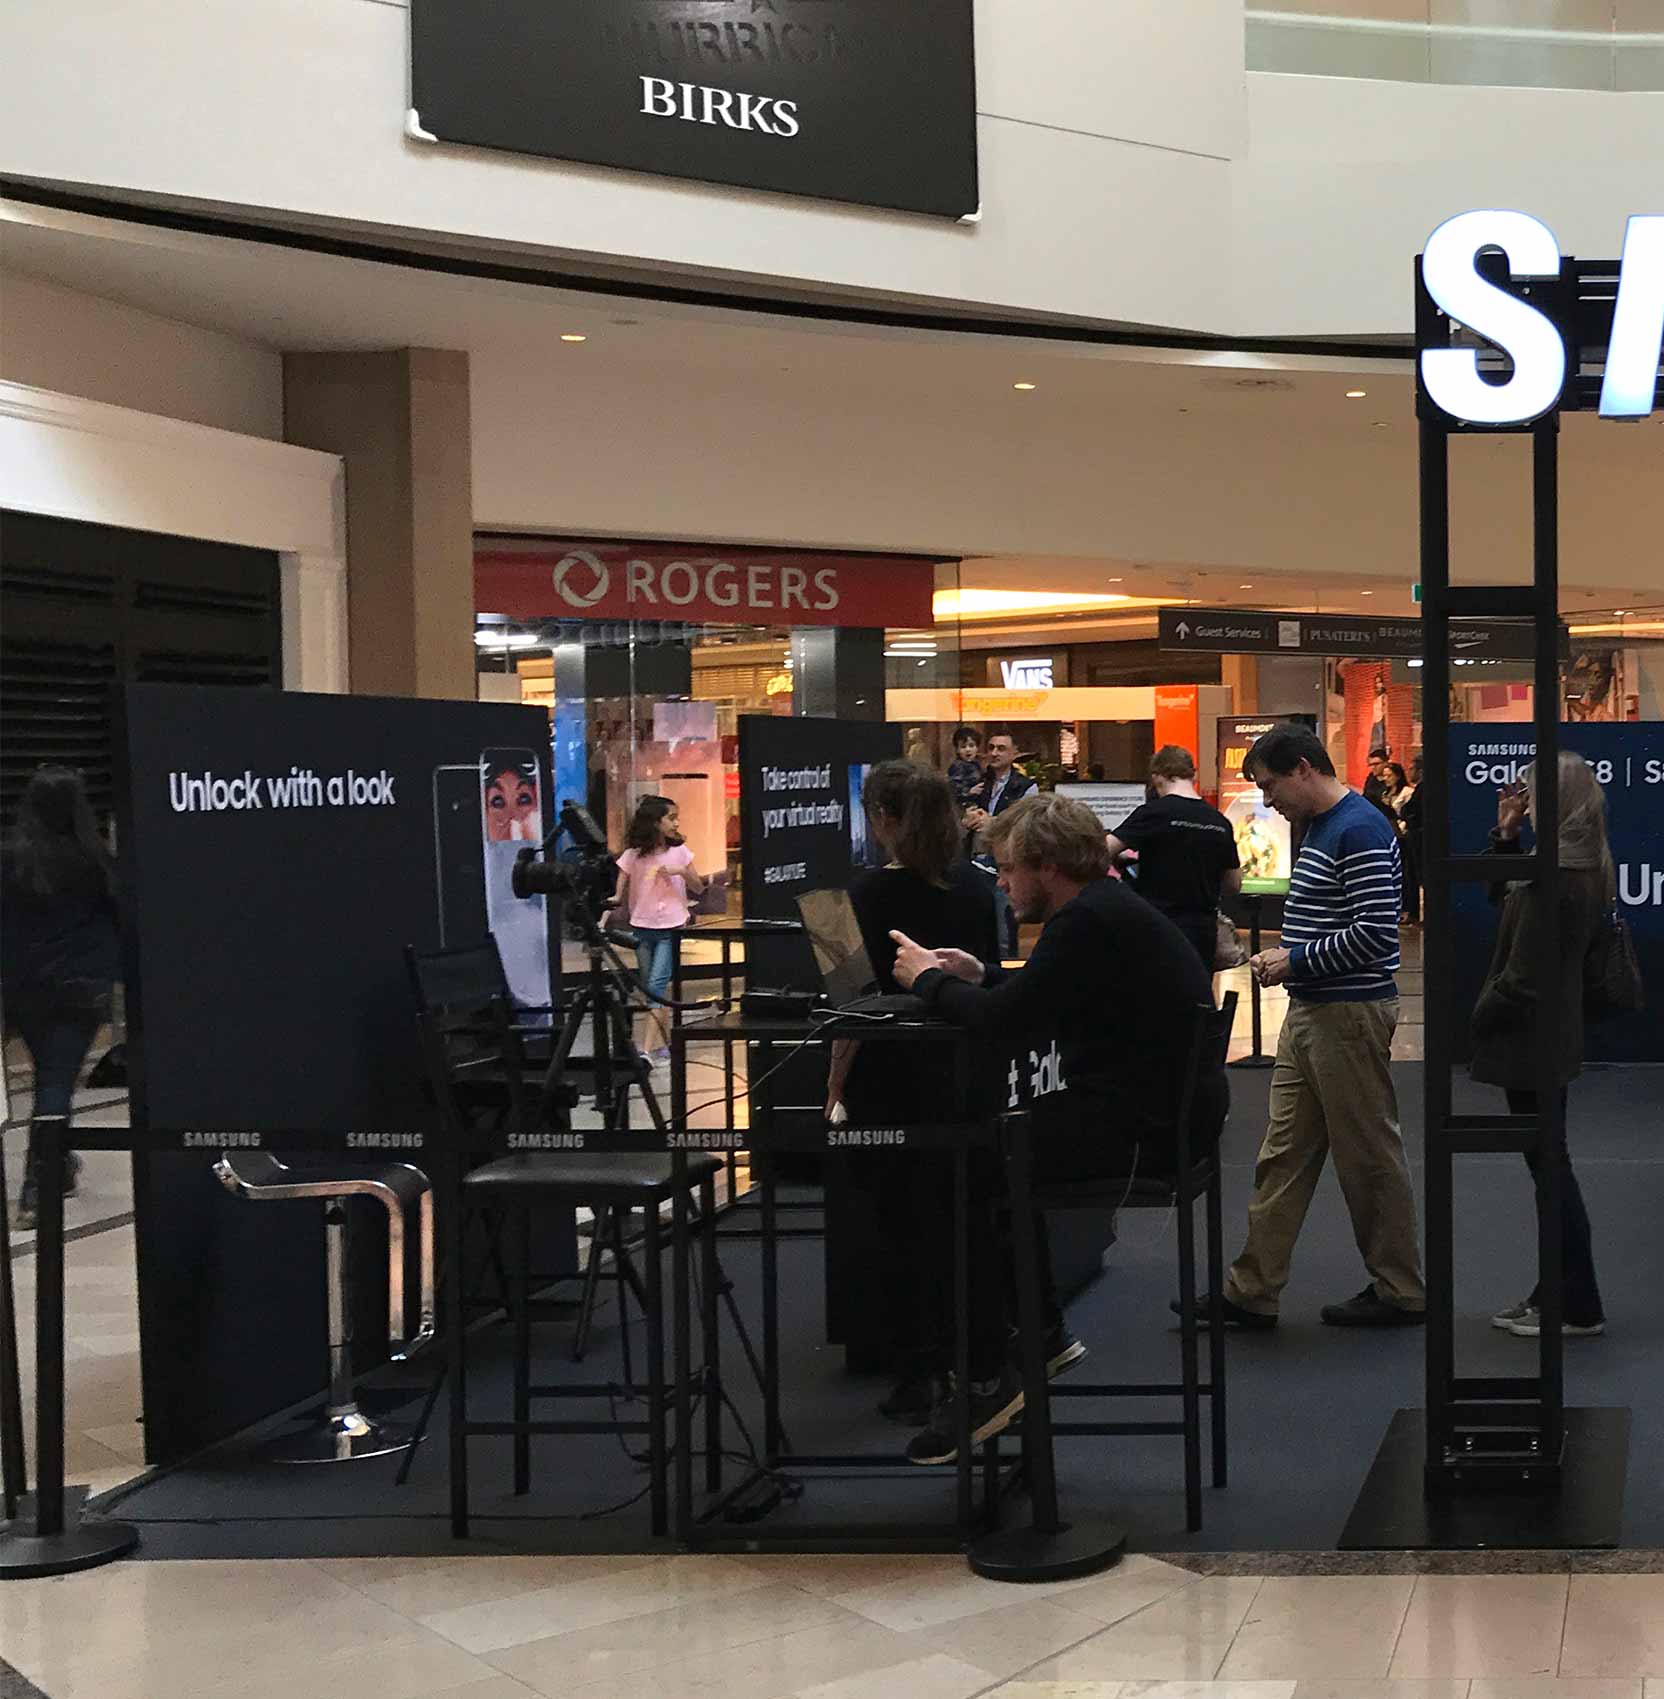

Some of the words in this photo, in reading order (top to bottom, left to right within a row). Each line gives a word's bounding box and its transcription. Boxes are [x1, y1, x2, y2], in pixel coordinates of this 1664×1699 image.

[639, 76, 800, 138] BIRKS
[627, 559, 840, 611] ROGERS
[1194, 625, 1224, 637] Guest
[1224, 626, 1261, 639] Services
[1001, 659, 1053, 689] VANS
[761, 766, 787, 791] Take
[788, 765, 820, 790] control
[820, 763, 831, 789] of
[168, 769, 263, 813] Unlock
[267, 766, 324, 809] with
[327, 775, 345, 807] a
[347, 767, 397, 806] look
[761, 807, 786, 838] your
[786, 801, 816, 828] virtual
[816, 798, 844, 831] reality
[184, 1132, 261, 1148] SAMSUNG
[346, 1132, 424, 1148] SAMSUNG
[508, 1132, 584, 1148] SAMSUNG
[666, 1131, 743, 1148] SAMSUNG
[827, 1129, 905, 1147] SAMSUNG
